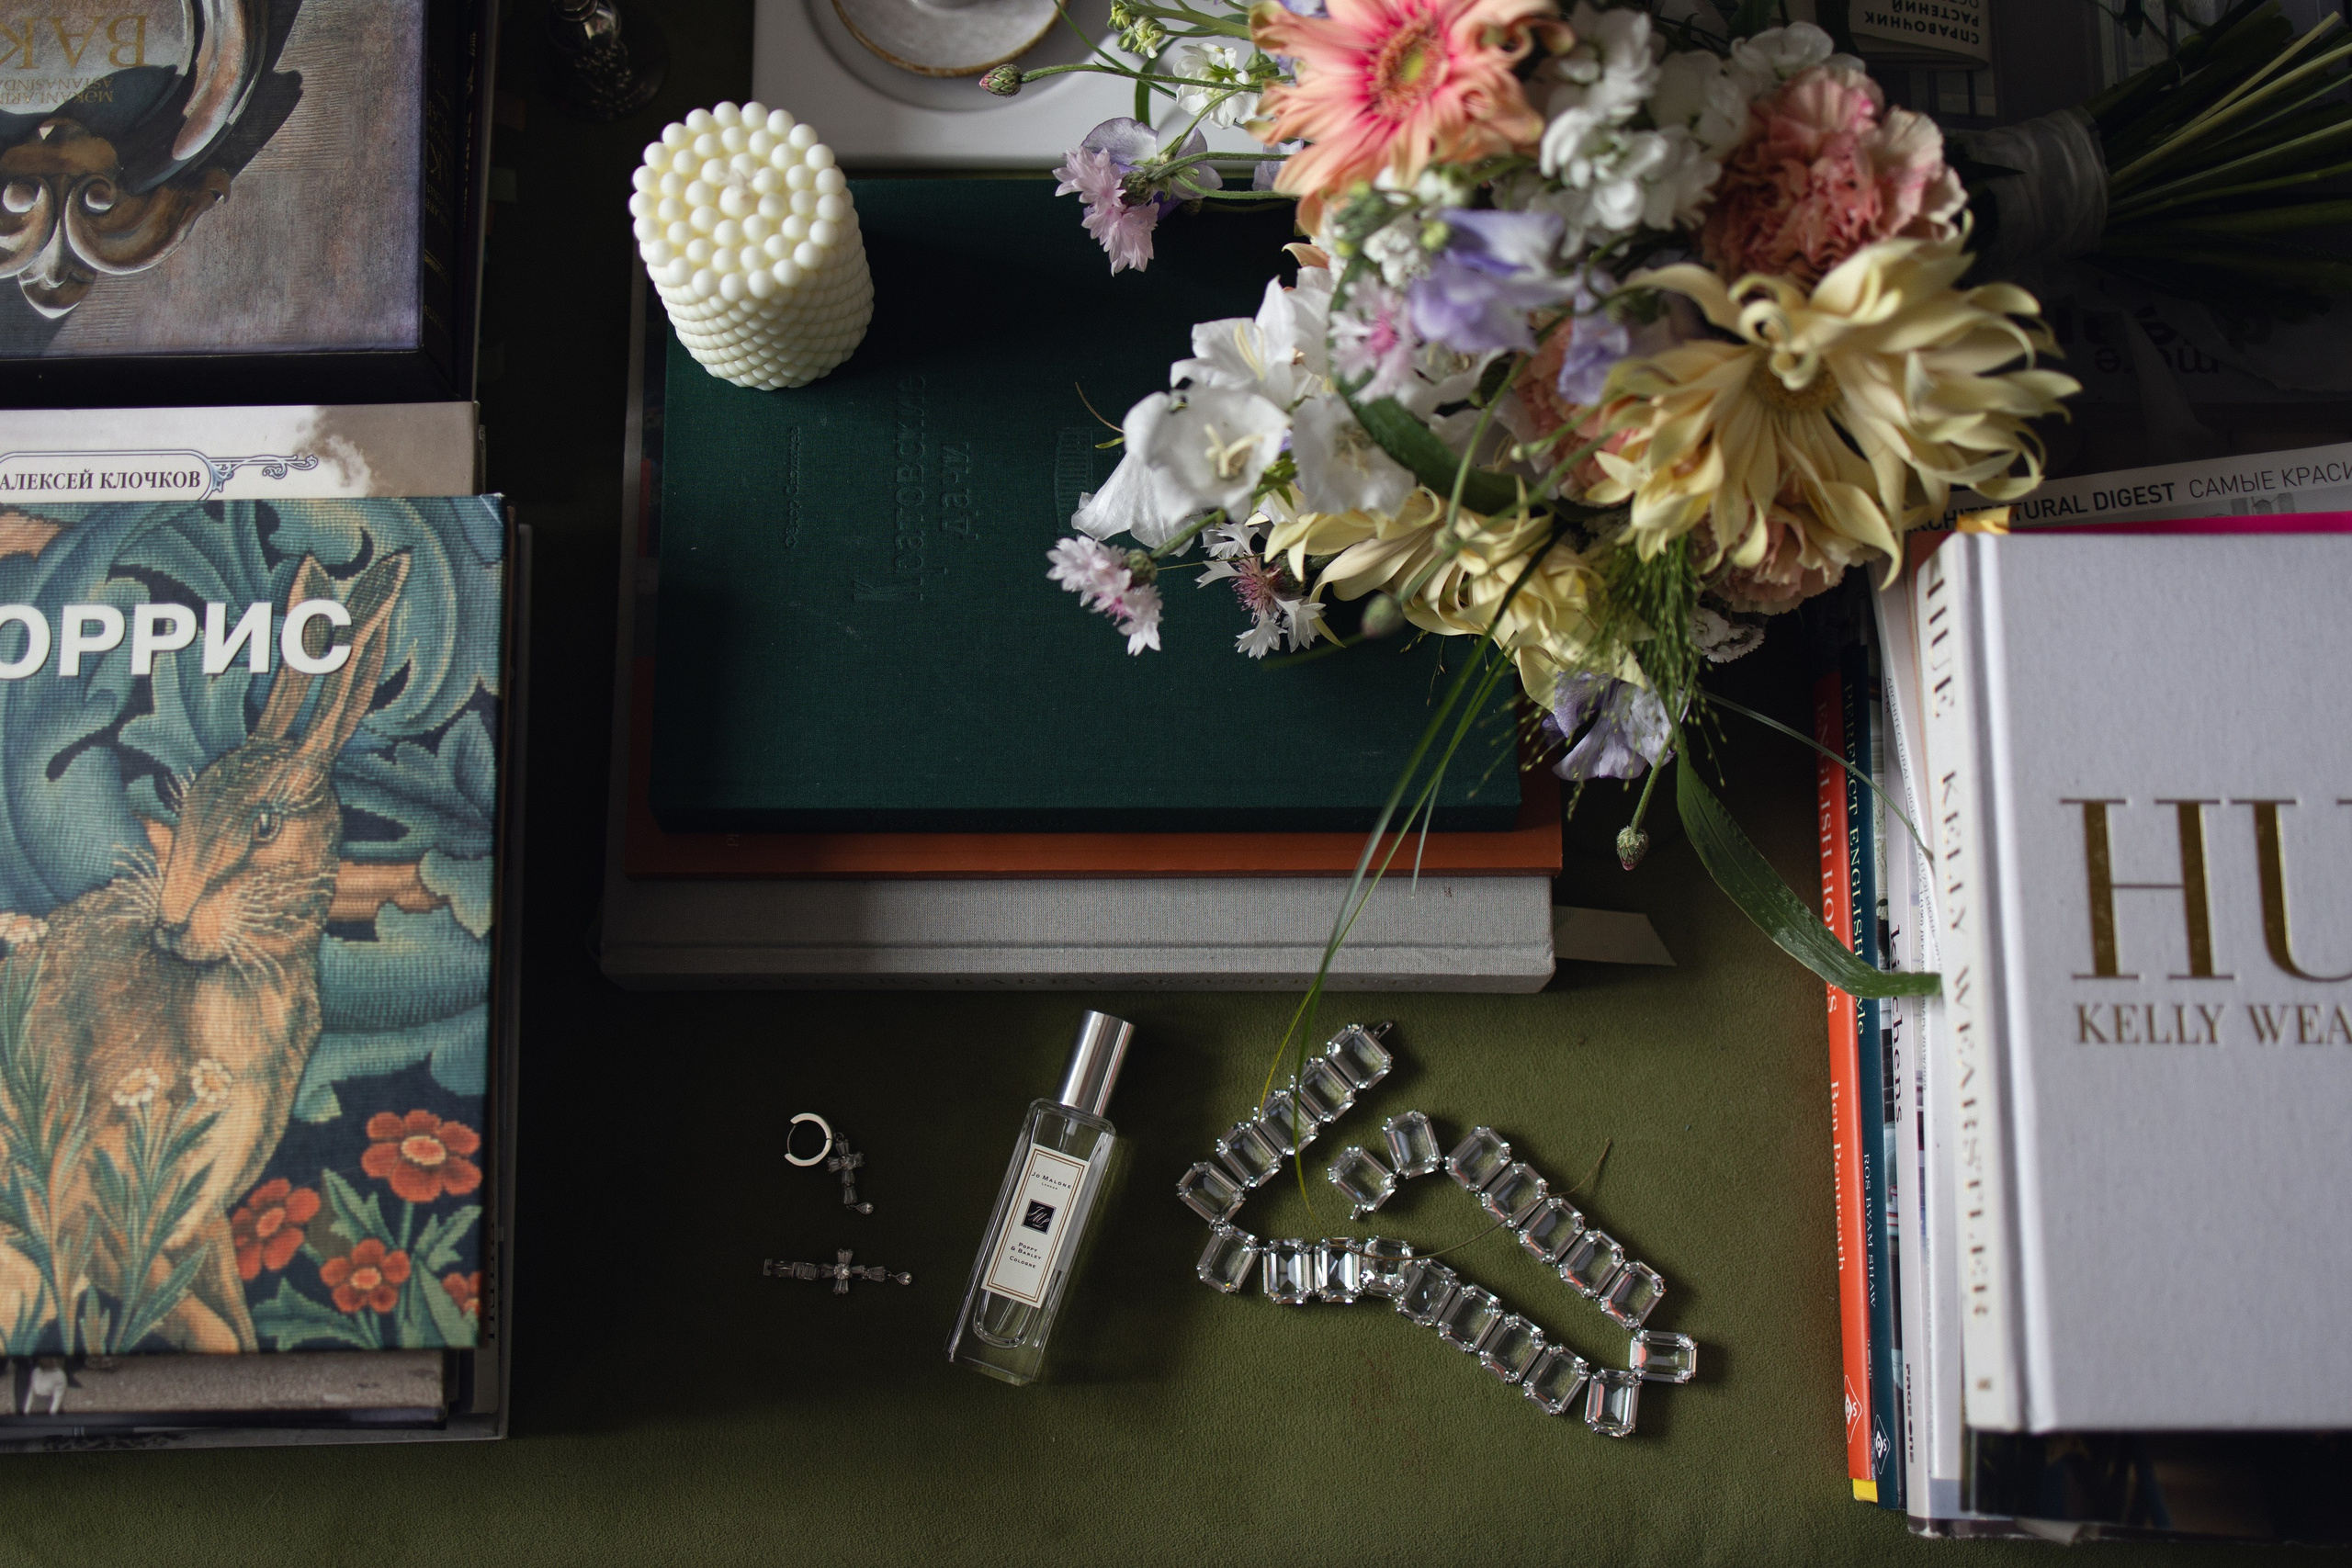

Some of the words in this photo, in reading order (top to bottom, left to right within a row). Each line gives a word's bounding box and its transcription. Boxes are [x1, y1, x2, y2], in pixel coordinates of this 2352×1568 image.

[1865, 11, 1980, 45] СПРАВОЧНИК
[1892, 0, 1979, 28] РАСТЕНИЙ
[0, 468, 94, 489] АЛЕКСЕЙ
[99, 469, 201, 489] КЛОЧКОВ
[2093, 482, 2175, 512] DIGEST
[2189, 470, 2275, 499] САМЫЕ
[0, 596, 354, 678] ОРРИС
[1844, 683, 1859, 816] PERFECT
[1886, 677, 1909, 780] ARCHITECTURAL
[1941, 771, 1969, 935] KELLY
[1849, 825, 1863, 956] ENGLISH
[2059, 798, 2352, 984] HU
[1890, 924, 1904, 1123] kichens
[2075, 1003, 2224, 1045] KELLY
[2246, 1003, 2352, 1045] WEA
[1831, 1080, 1839, 1132] Ben
[1833, 1142, 1846, 1271] Pentreath
[1865, 1196, 1873, 1247] BYAM
[1009, 1255, 1036, 1269] COLOGNE
[1868, 1254, 1876, 1308] SHAW
